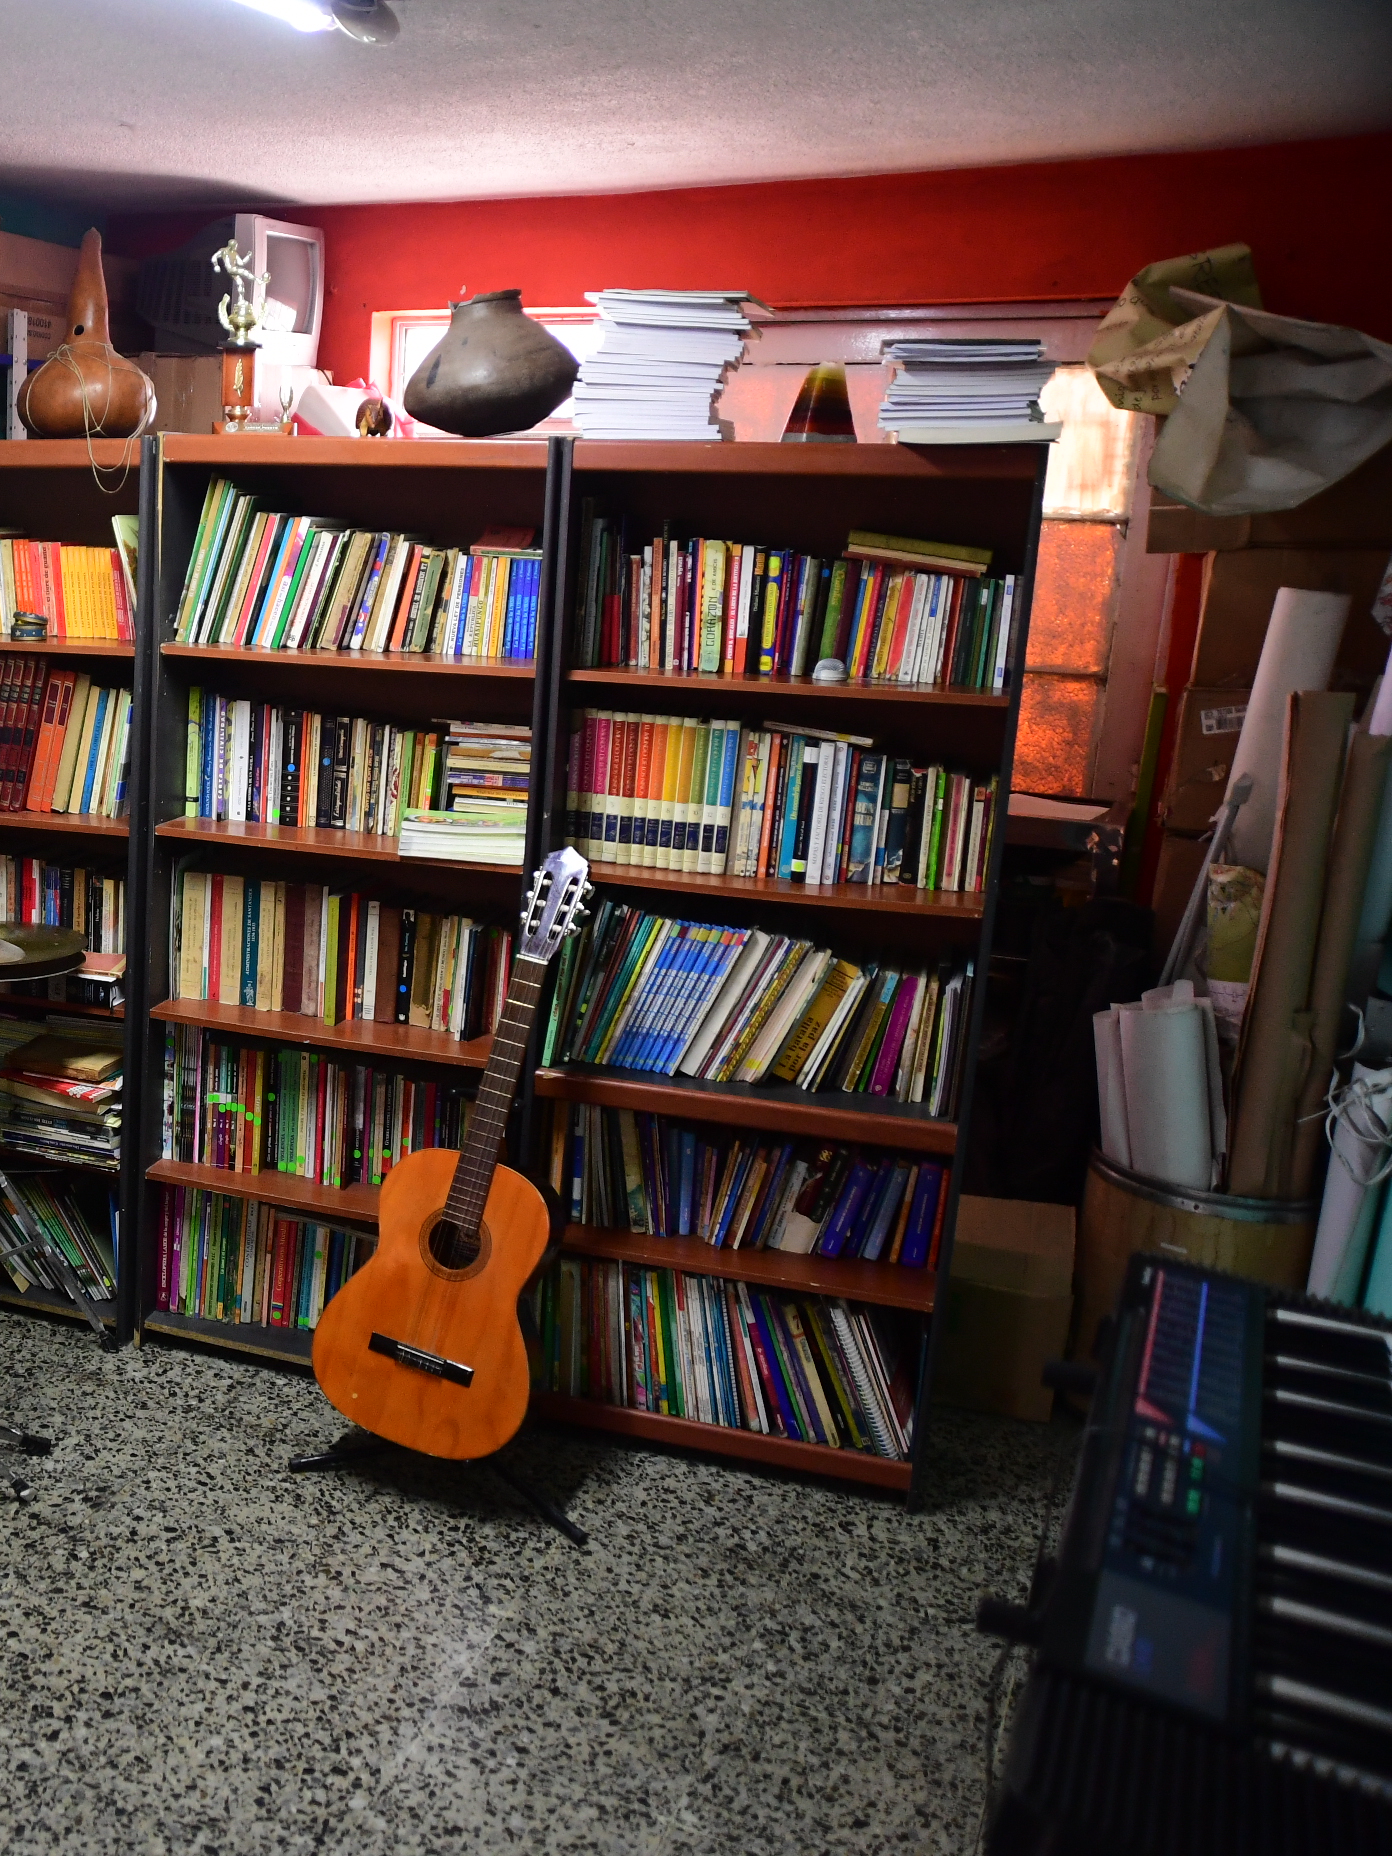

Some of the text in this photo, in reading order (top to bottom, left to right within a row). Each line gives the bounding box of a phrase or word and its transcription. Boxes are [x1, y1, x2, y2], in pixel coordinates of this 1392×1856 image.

[450, 567, 465, 642] NUEVA LEY DE PENSIONES
[472, 599, 484, 648] HUASIPUNGO
[218, 711, 226, 754] CIVILIDAD
[88, 752, 97, 771] OBRAS
[218, 758, 224, 769] DE
[820, 754, 830, 785] ELECTORAL
[818, 786, 826, 805] RIESGO
[817, 806, 824, 815] DE
[814, 816, 823, 841] FACTORES
[811, 846, 820, 865] MAPAS
[246, 918, 252, 926] DE
[779, 1016, 814, 1068] La batalla
[788, 1020, 823, 1072] por la paz
[244, 1219, 253, 1268] CONTABILIDAD
